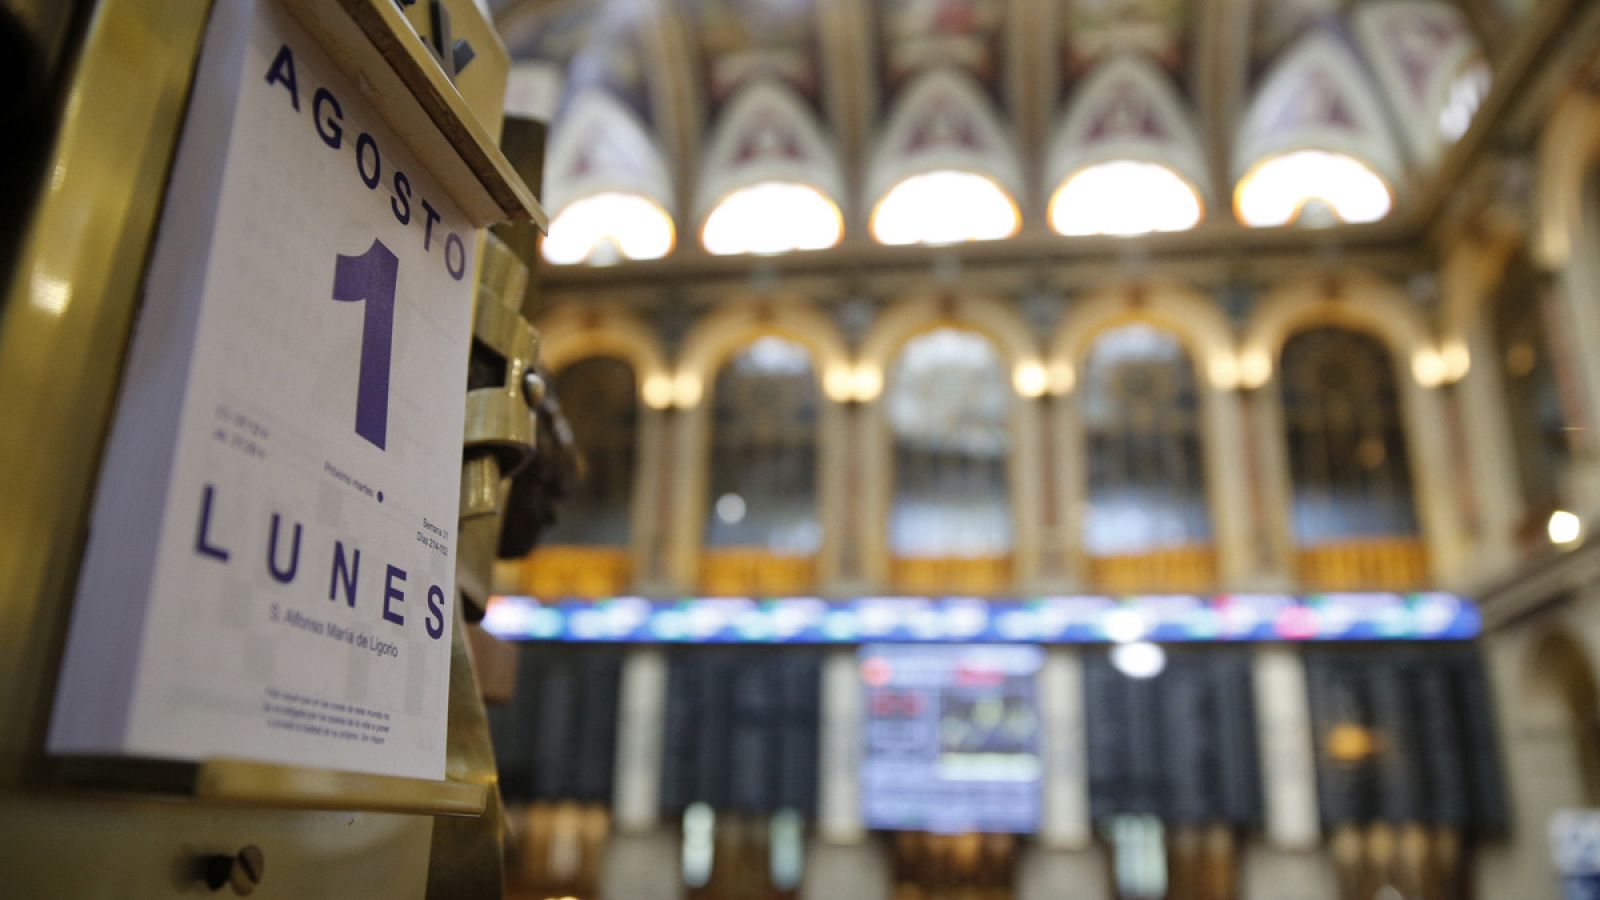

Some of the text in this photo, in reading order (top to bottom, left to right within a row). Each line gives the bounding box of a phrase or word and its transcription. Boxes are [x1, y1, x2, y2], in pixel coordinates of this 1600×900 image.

[265, 44, 465, 281] AGOSTO
[332, 238, 399, 451] 1
[194, 484, 446, 641] LUNES
[356, 634, 368, 649] de
[370, 636, 398, 658] Ligorio
